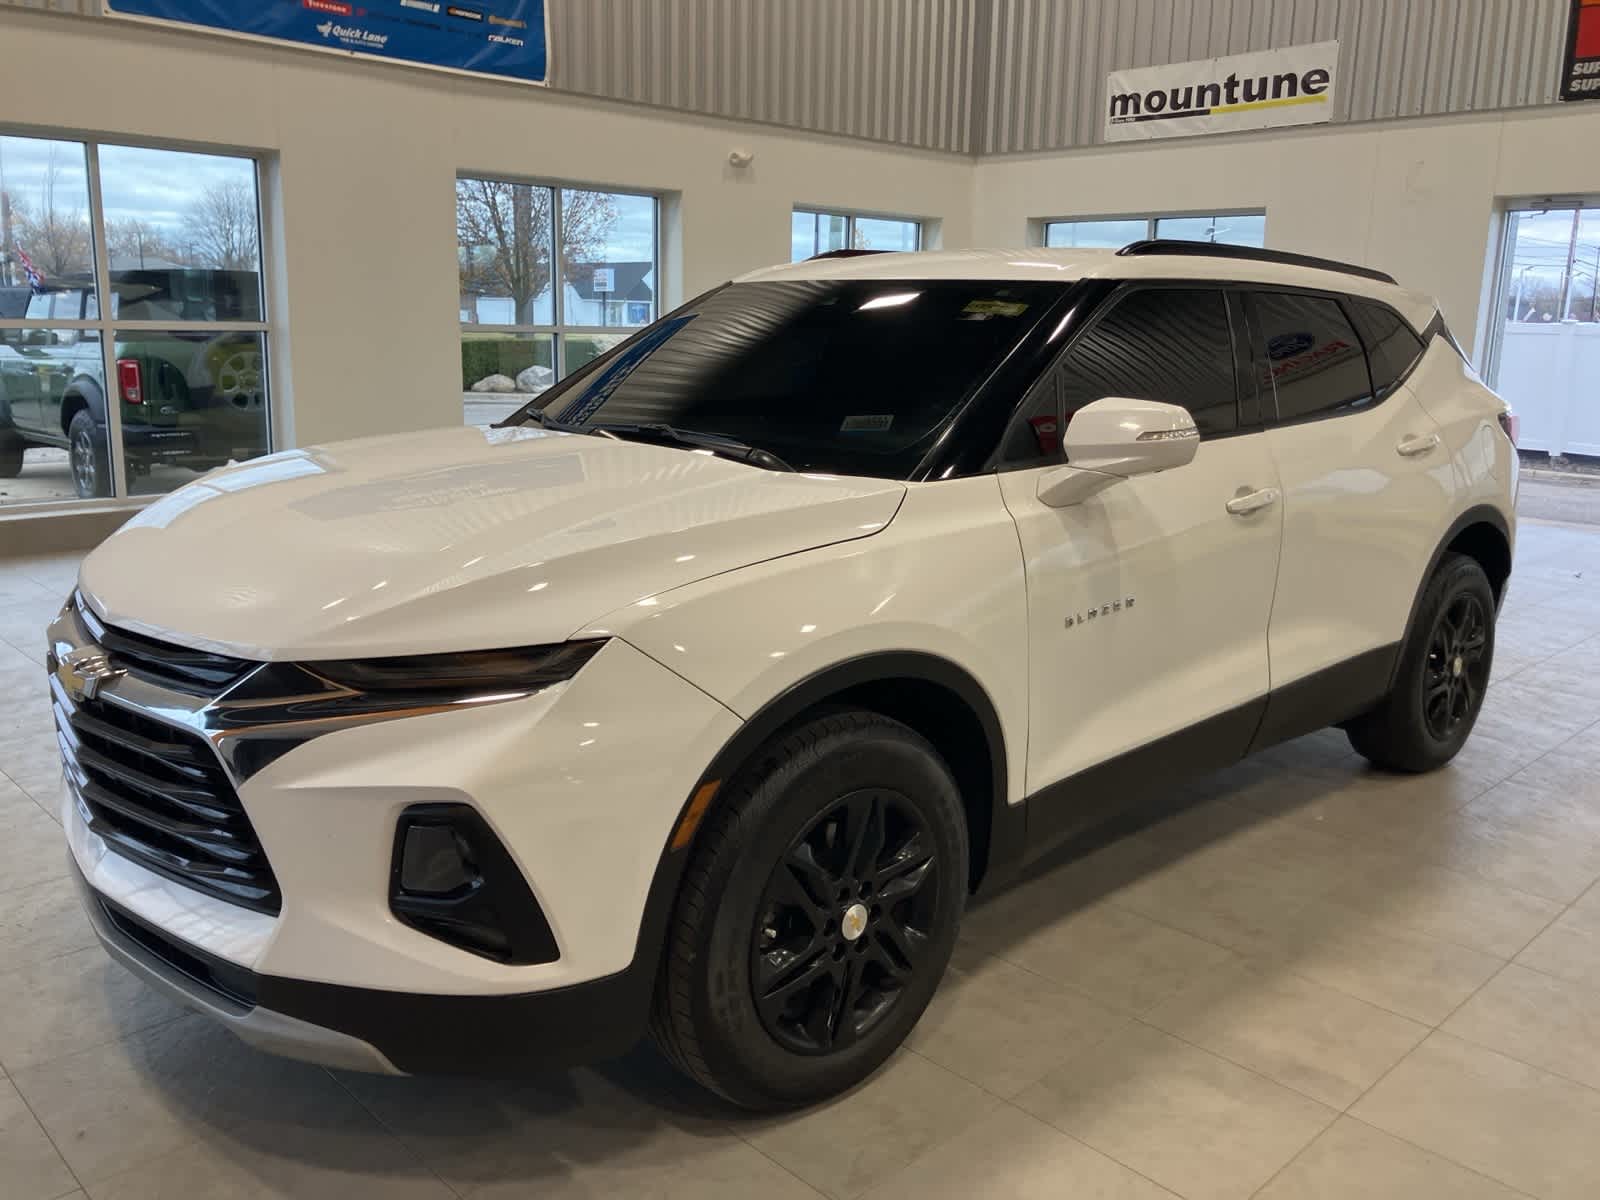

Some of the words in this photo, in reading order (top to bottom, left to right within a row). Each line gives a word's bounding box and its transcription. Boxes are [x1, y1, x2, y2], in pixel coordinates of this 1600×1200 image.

[332, 25, 361, 38] Quick
[362, 30, 388, 44] Lane
[1109, 68, 1330, 117] mountune
[1065, 598, 1135, 629] BLAZER
